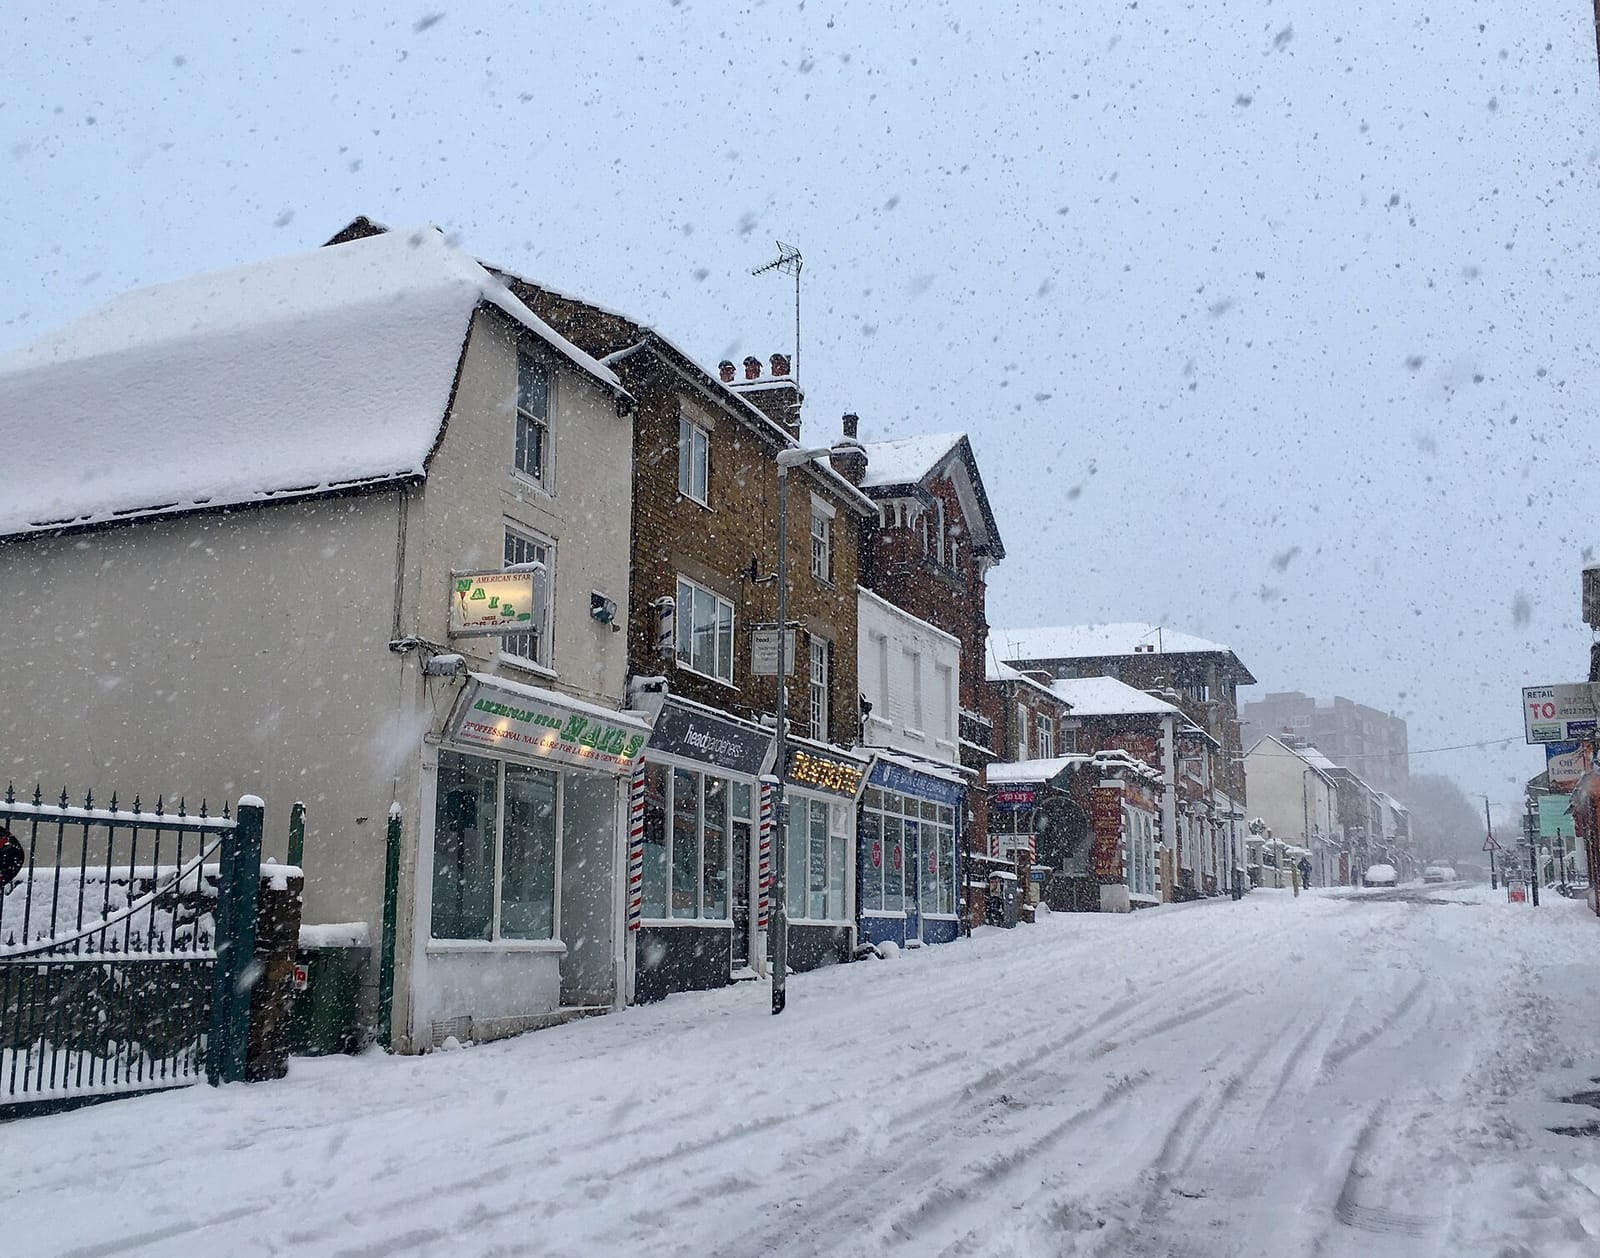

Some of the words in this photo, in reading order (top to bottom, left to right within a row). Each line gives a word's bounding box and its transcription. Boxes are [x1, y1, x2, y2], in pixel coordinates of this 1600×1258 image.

[475, 575, 512, 584] AMERICAN
[513, 573, 531, 581] STAR
[1527, 690, 1555, 699] RETAIL
[1529, 702, 1556, 720] TO
[474, 699, 534, 722] AMERICAN
[533, 713, 563, 730] STAR
[560, 713, 644, 758] NAILS
[522, 735, 539, 746] NAIL
[539, 738, 558, 750] CARE
[1559, 758, 1574, 768] Off
[1003, 792, 1014, 802] TO
[1014, 792, 1028, 803] LET
